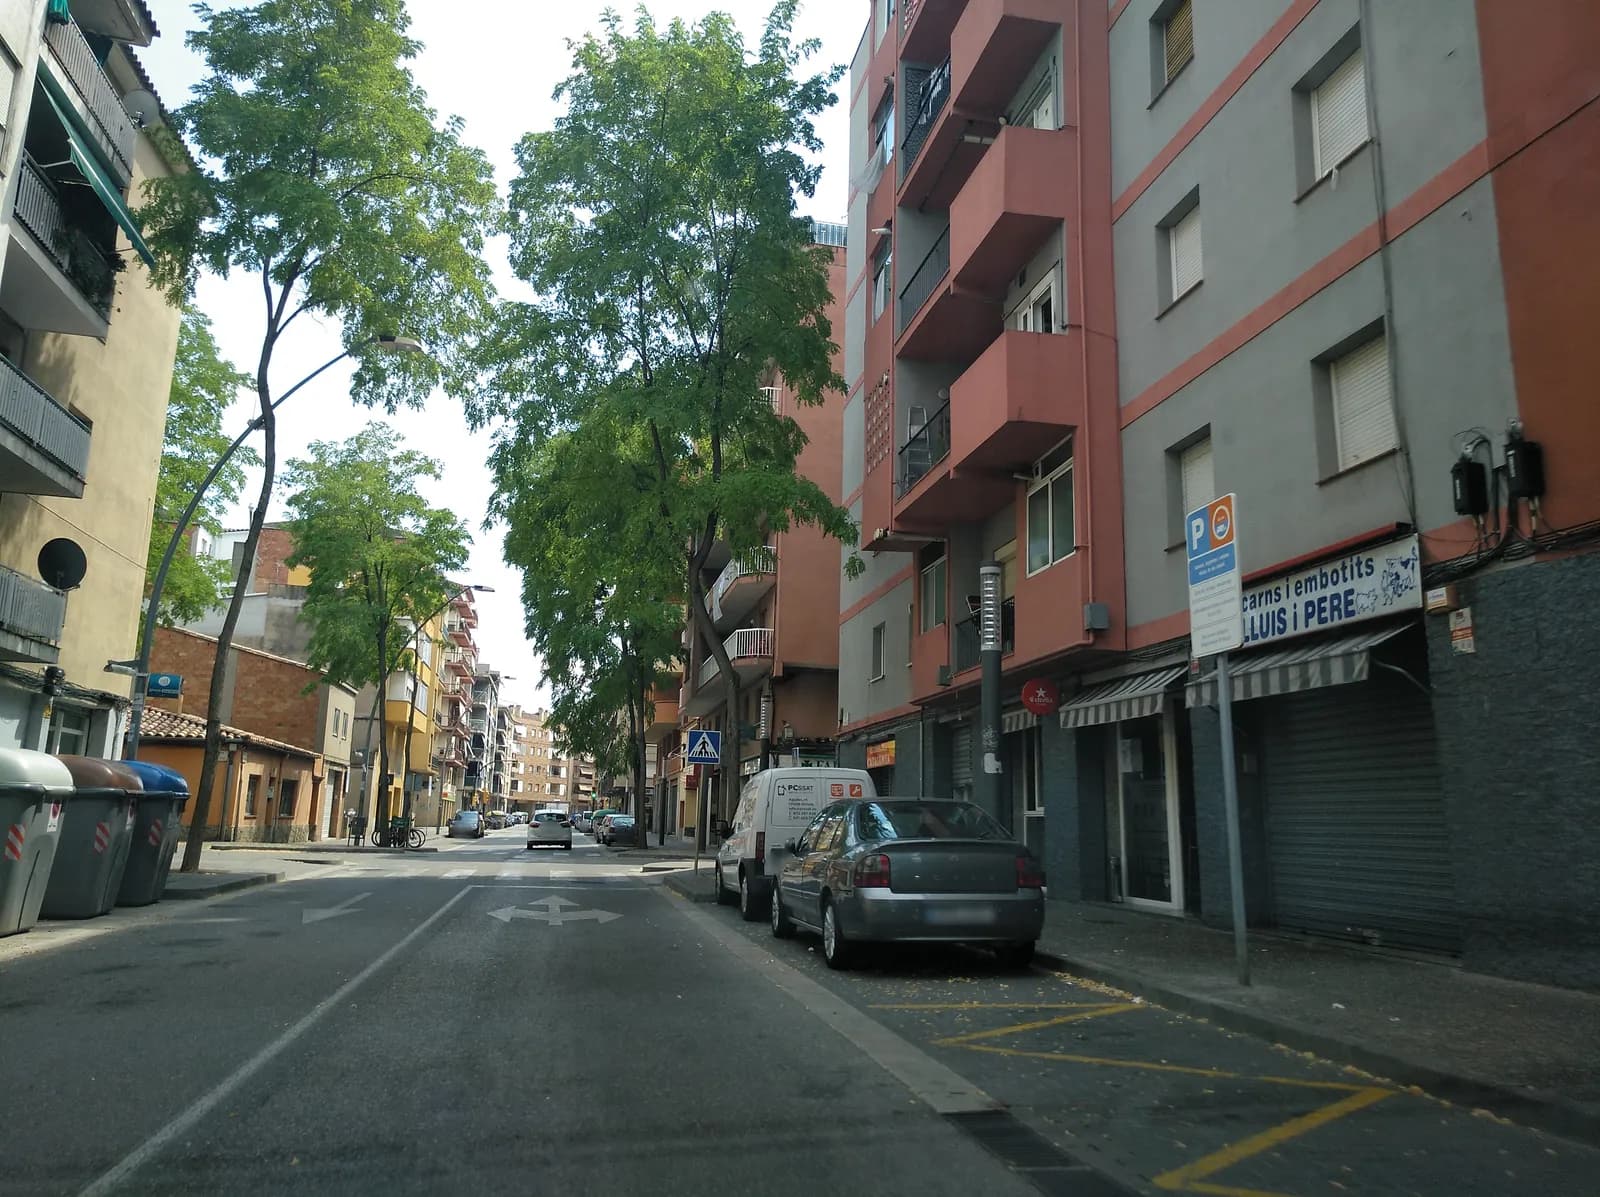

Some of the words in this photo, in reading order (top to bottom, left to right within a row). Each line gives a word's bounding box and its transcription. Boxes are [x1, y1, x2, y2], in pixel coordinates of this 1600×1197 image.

[1192, 518, 1204, 550] P
[1242, 585, 1281, 612] carns
[1286, 577, 1290, 599] i
[1294, 556, 1374, 596] embotits
[1243, 607, 1287, 643] LLUIS
[1293, 603, 1297, 631] i
[1304, 588, 1356, 628] PERE
